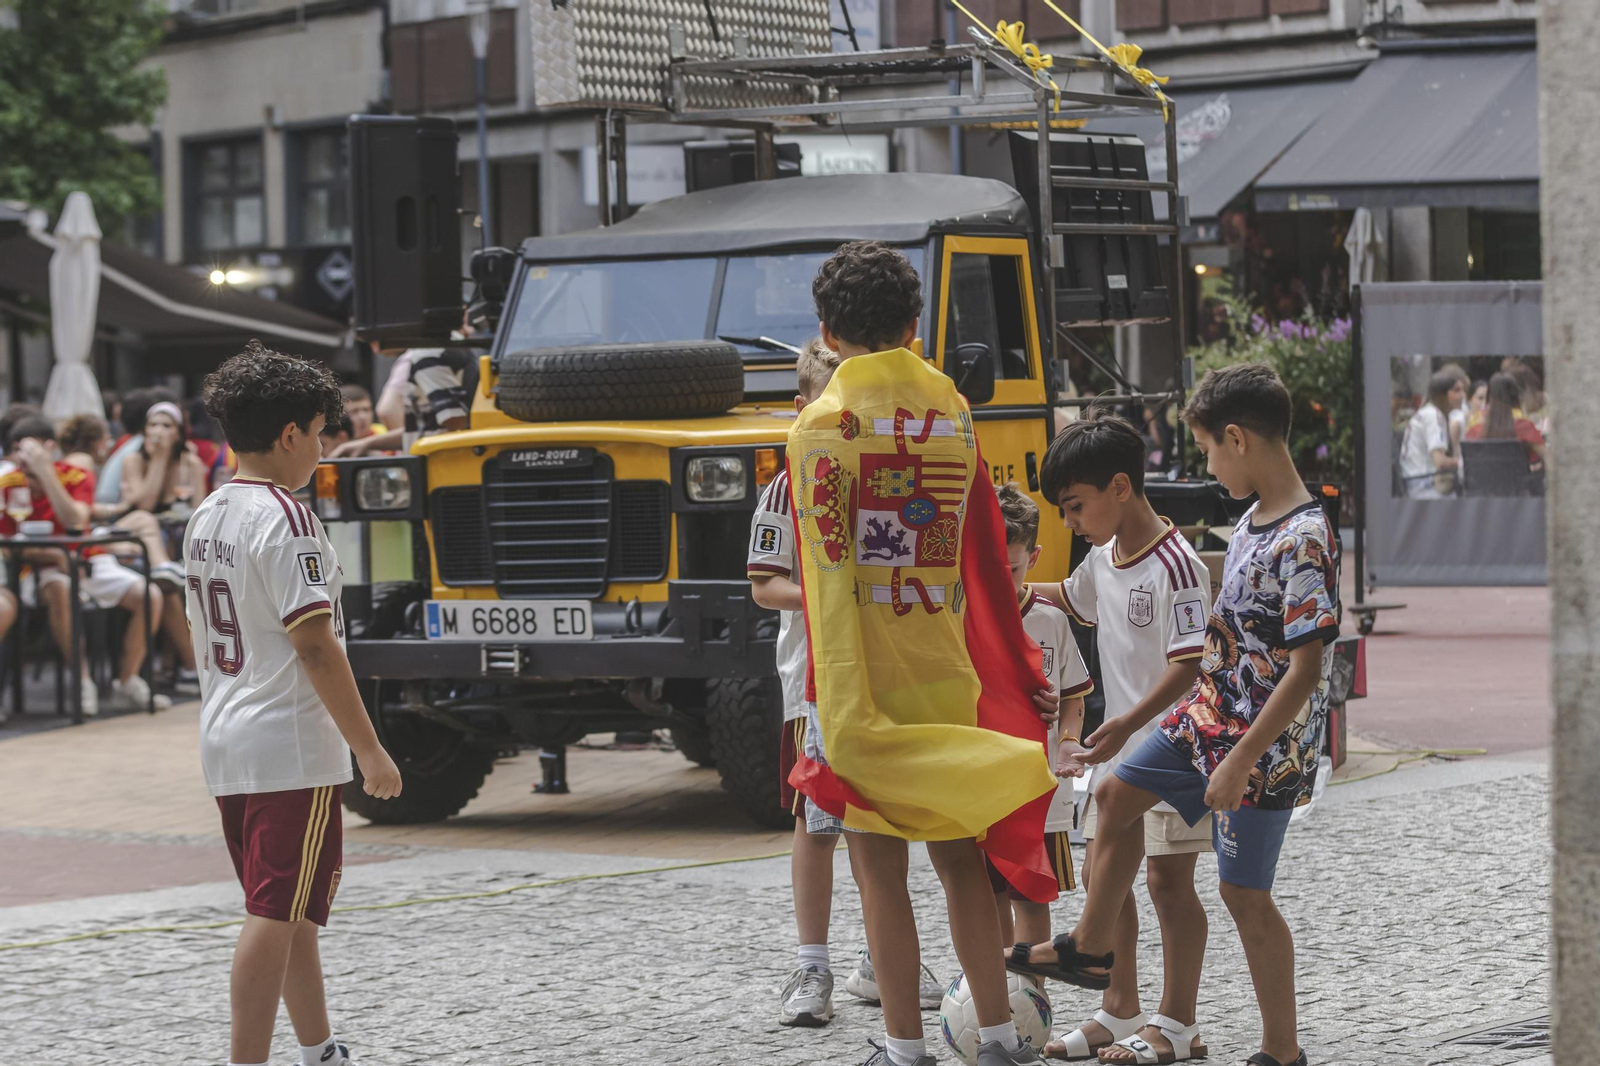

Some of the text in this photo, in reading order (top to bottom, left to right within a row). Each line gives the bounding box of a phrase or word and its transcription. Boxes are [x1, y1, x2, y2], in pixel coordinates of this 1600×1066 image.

[511, 449, 579, 462] LAND-ROVER
[442, 607, 586, 635] M 6688 ED
